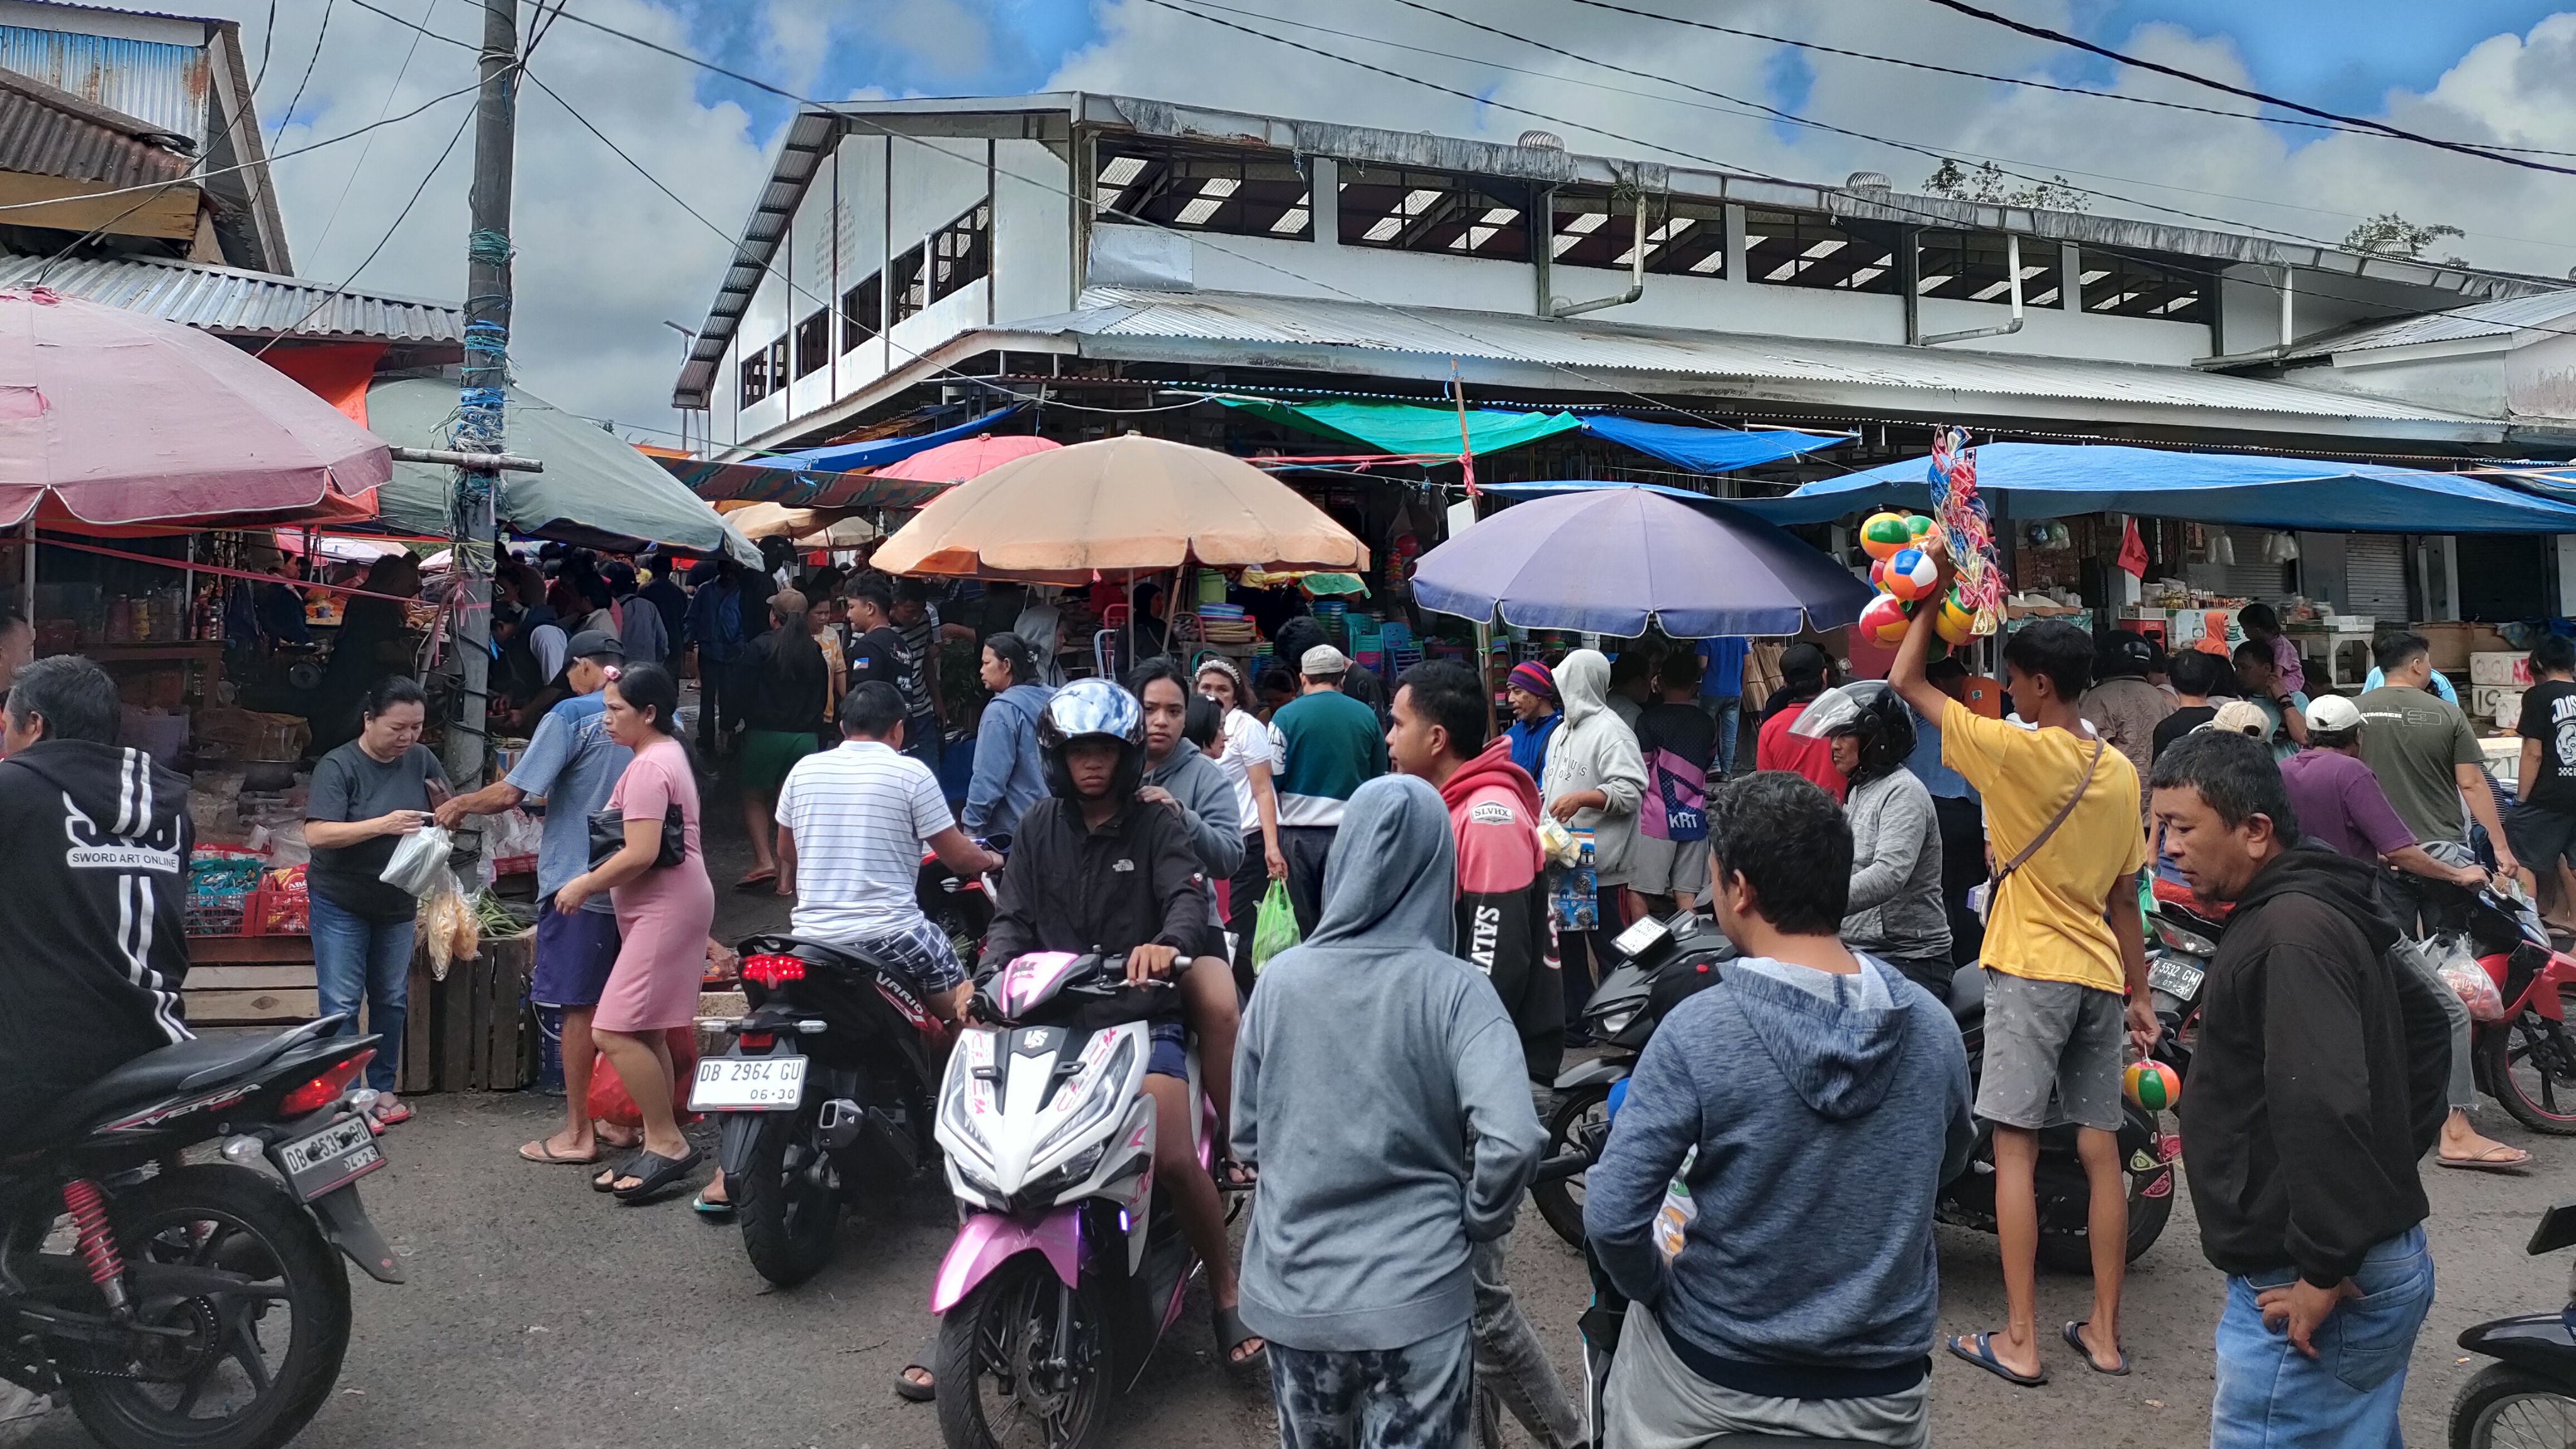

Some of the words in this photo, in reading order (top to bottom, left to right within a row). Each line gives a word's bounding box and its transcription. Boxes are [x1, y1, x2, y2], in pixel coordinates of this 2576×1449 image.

[1668, 812, 1697, 828] KRT
[72, 853, 117, 862] SWORD
[119, 853, 141, 863] ART
[143, 855, 176, 868] ONLINE
[2159, 962, 2180, 977] 5532
[2182, 969, 2200, 985] GM
[876, 971, 923, 1014] VARIO
[700, 1064, 721, 1082] DB
[731, 1063, 772, 1080] 2964
[780, 1062, 801, 1080] GU
[145, 1083, 262, 1125] VERZA
[286, 1148, 308, 1172] DB
